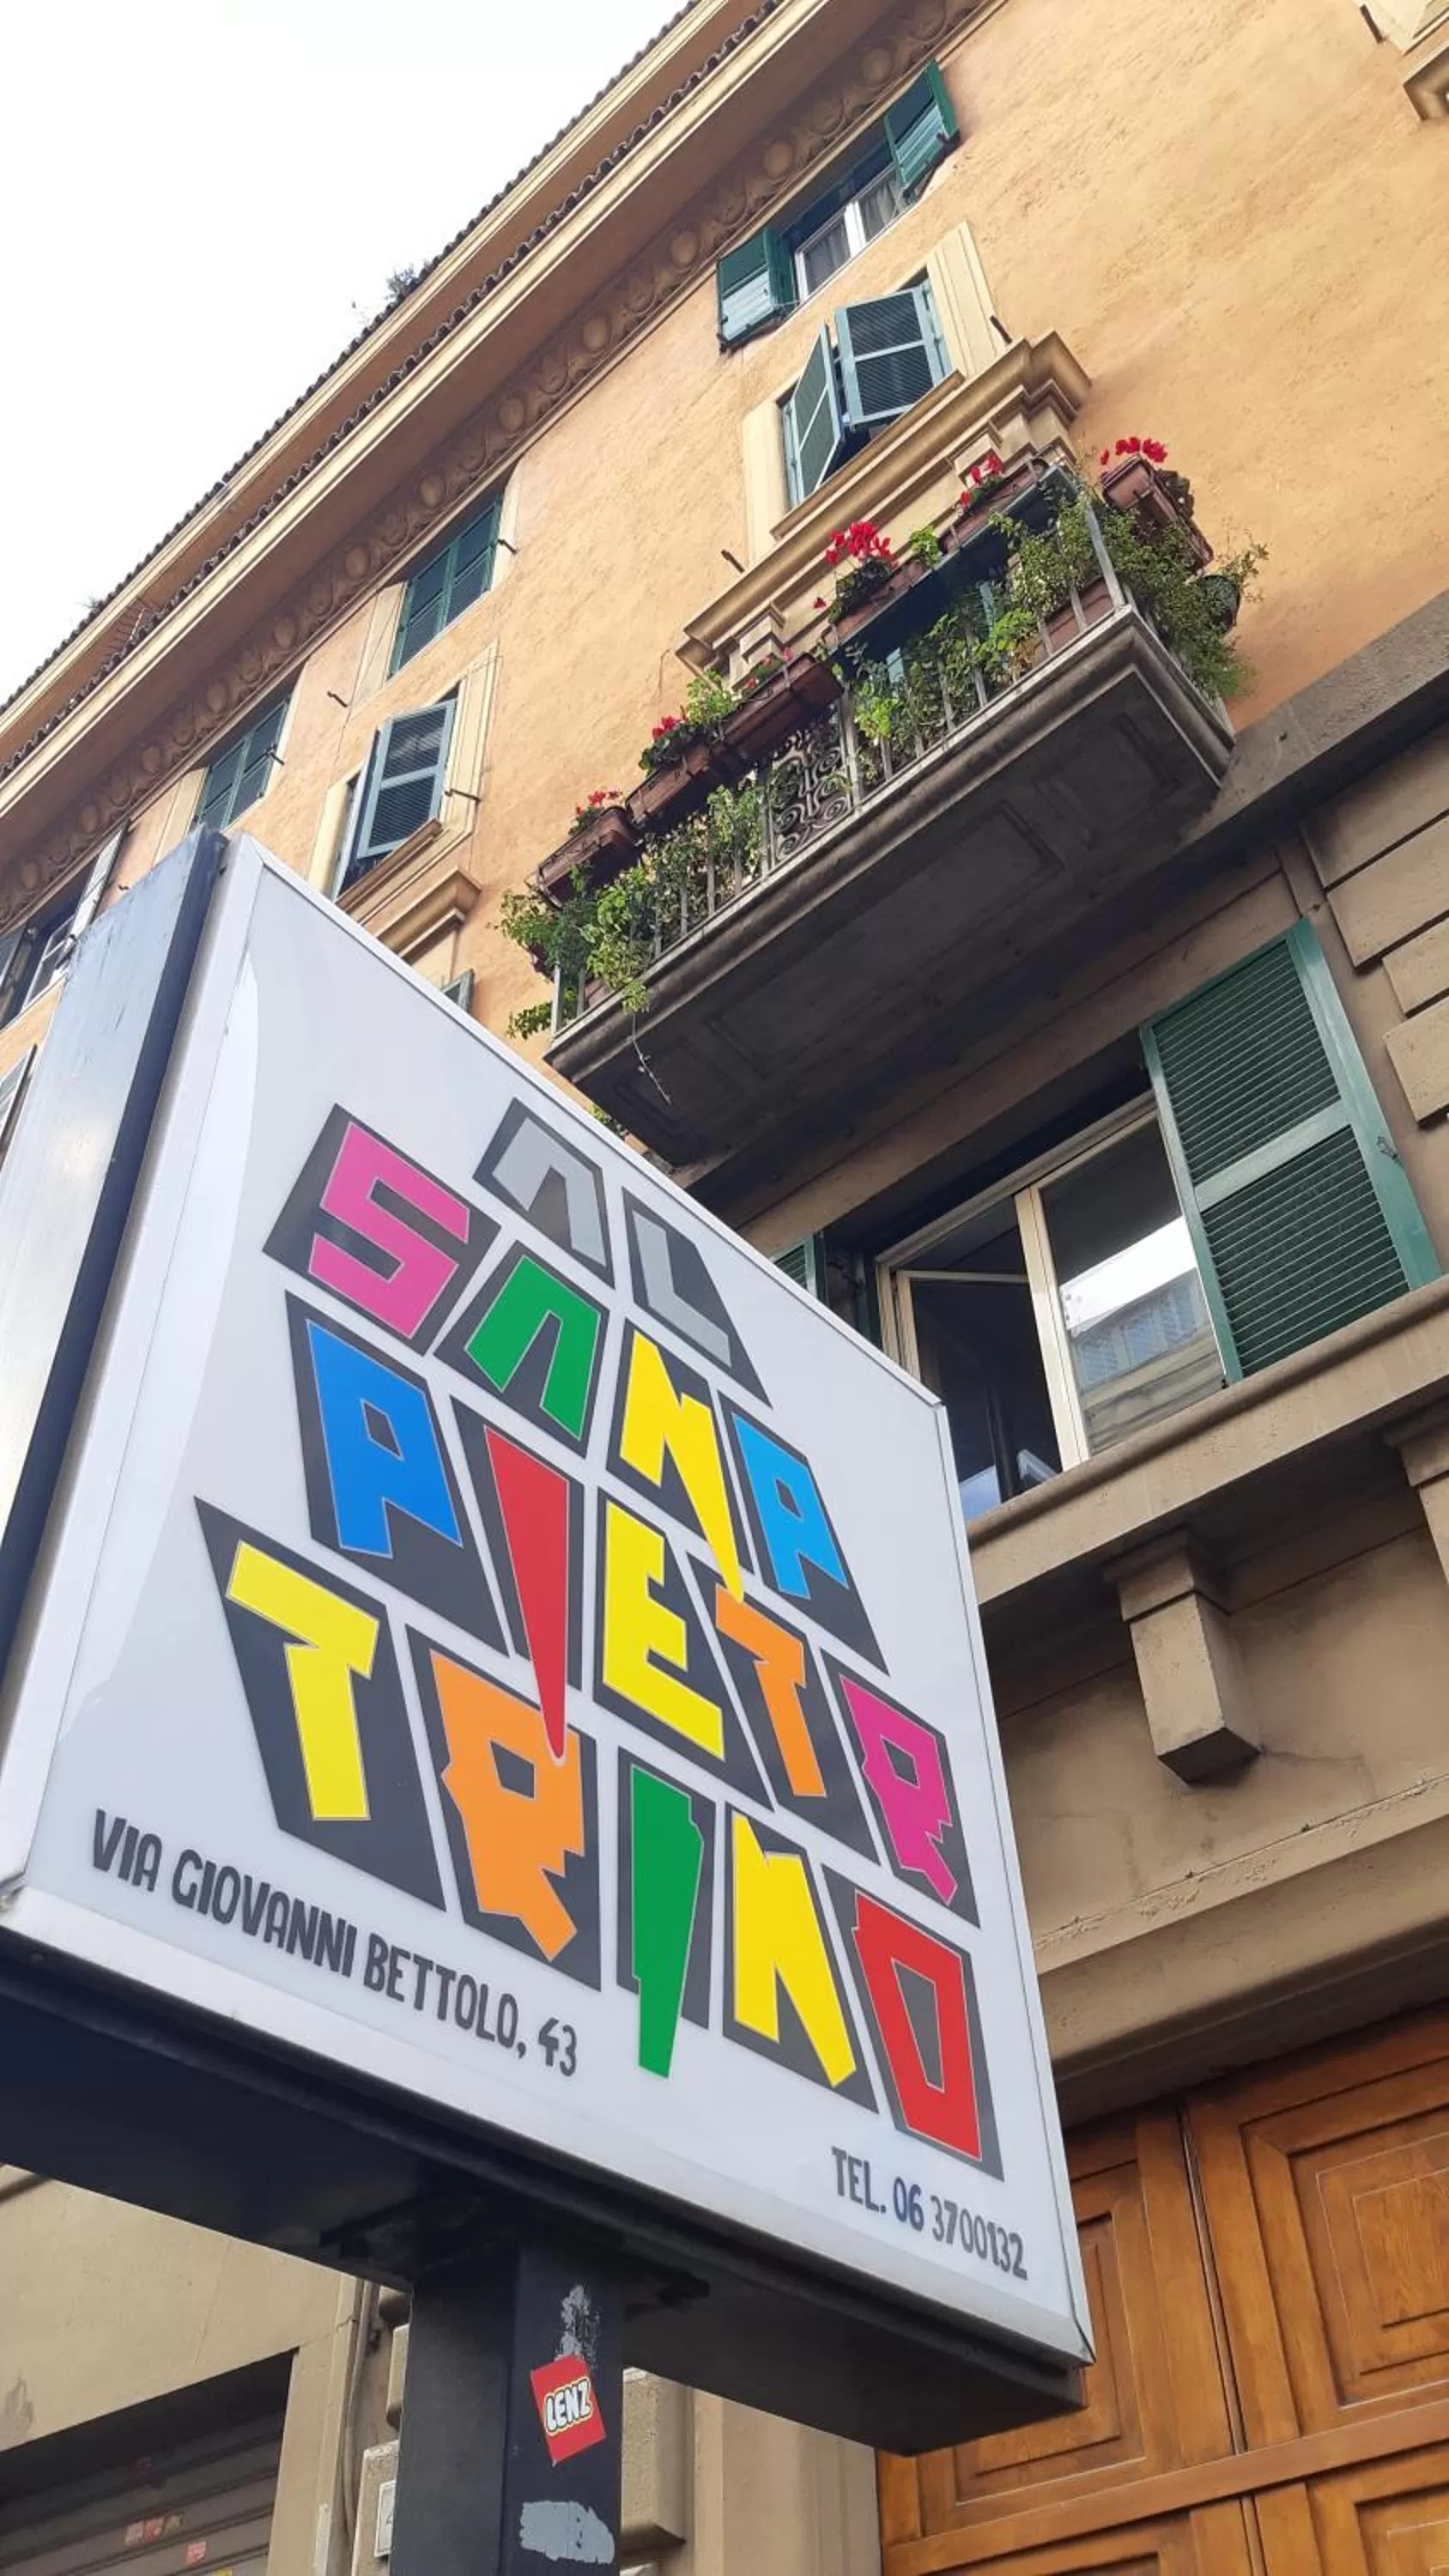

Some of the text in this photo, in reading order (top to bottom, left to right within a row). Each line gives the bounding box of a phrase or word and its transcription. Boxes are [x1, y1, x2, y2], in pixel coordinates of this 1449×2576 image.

[492, 1117, 731, 1369] AL
[93, 1809, 577, 2076] VIA GIOVANNI BETTOLO, 43
[831, 2145, 1028, 2281] TEL. 06 3700132
[544, 2379, 591, 2433] LENZ
